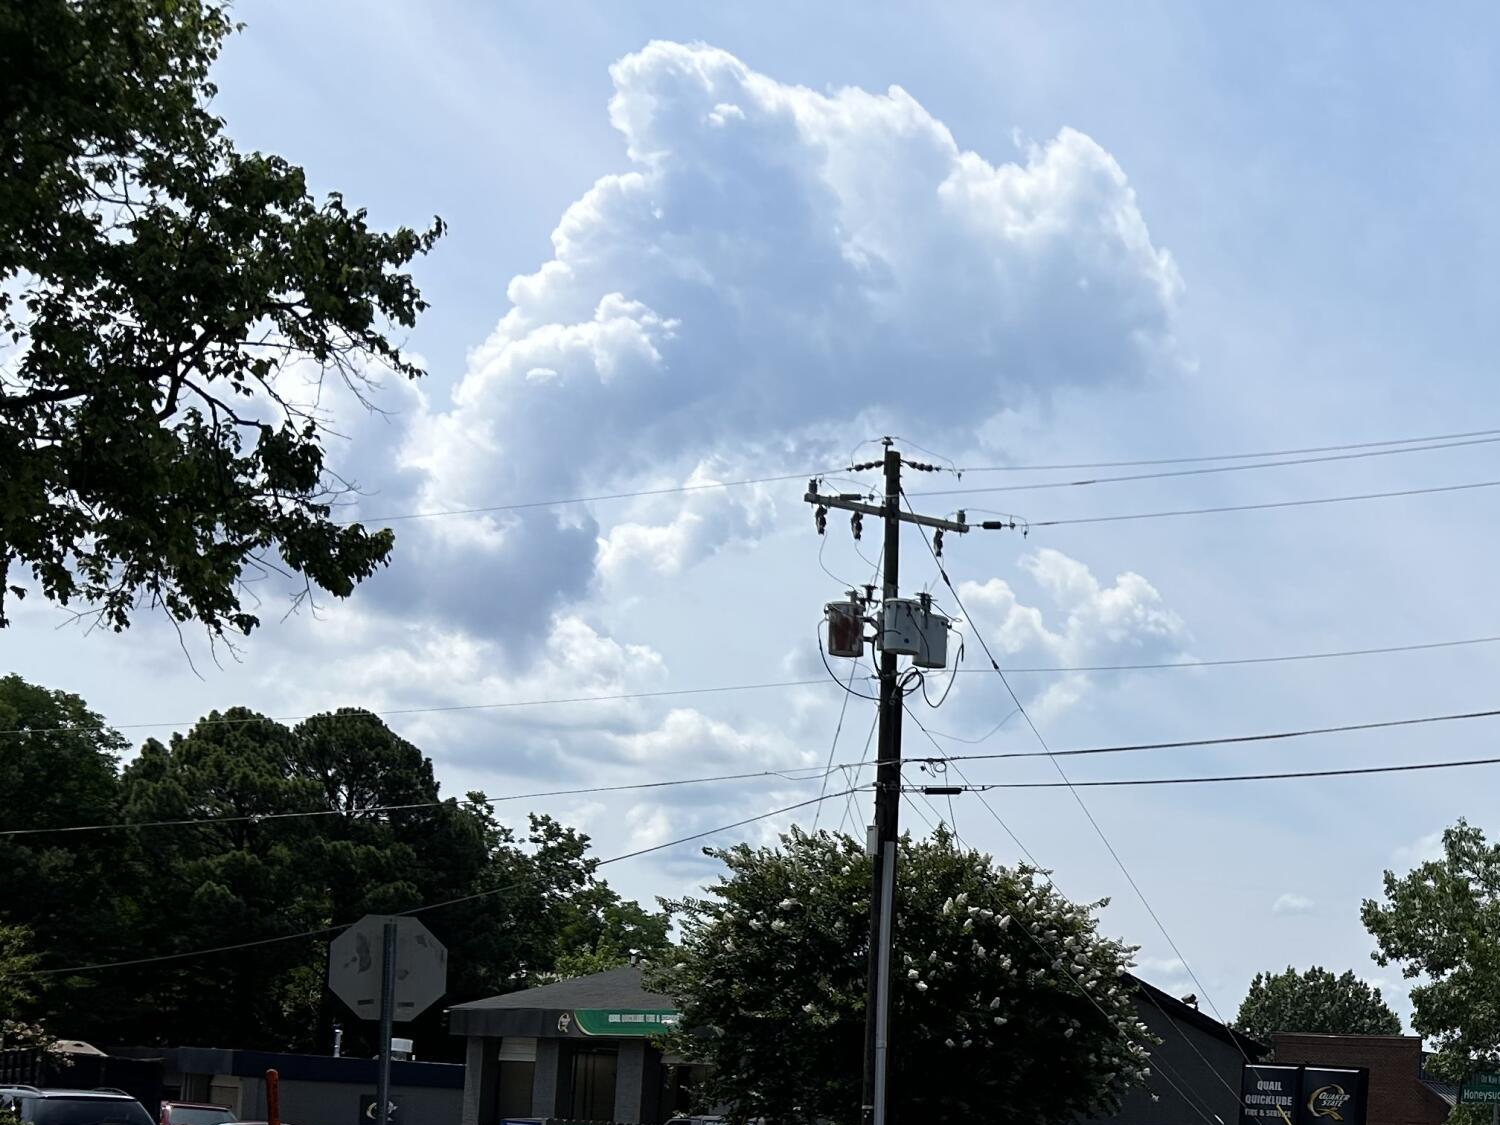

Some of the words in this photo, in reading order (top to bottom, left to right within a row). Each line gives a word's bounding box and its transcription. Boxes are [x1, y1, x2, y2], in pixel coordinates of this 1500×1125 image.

[1257, 1080, 1283, 1091] QUAIL
[1245, 1094, 1293, 1106] QUICKLUBE
[1318, 1092, 1350, 1101] QUAKER
